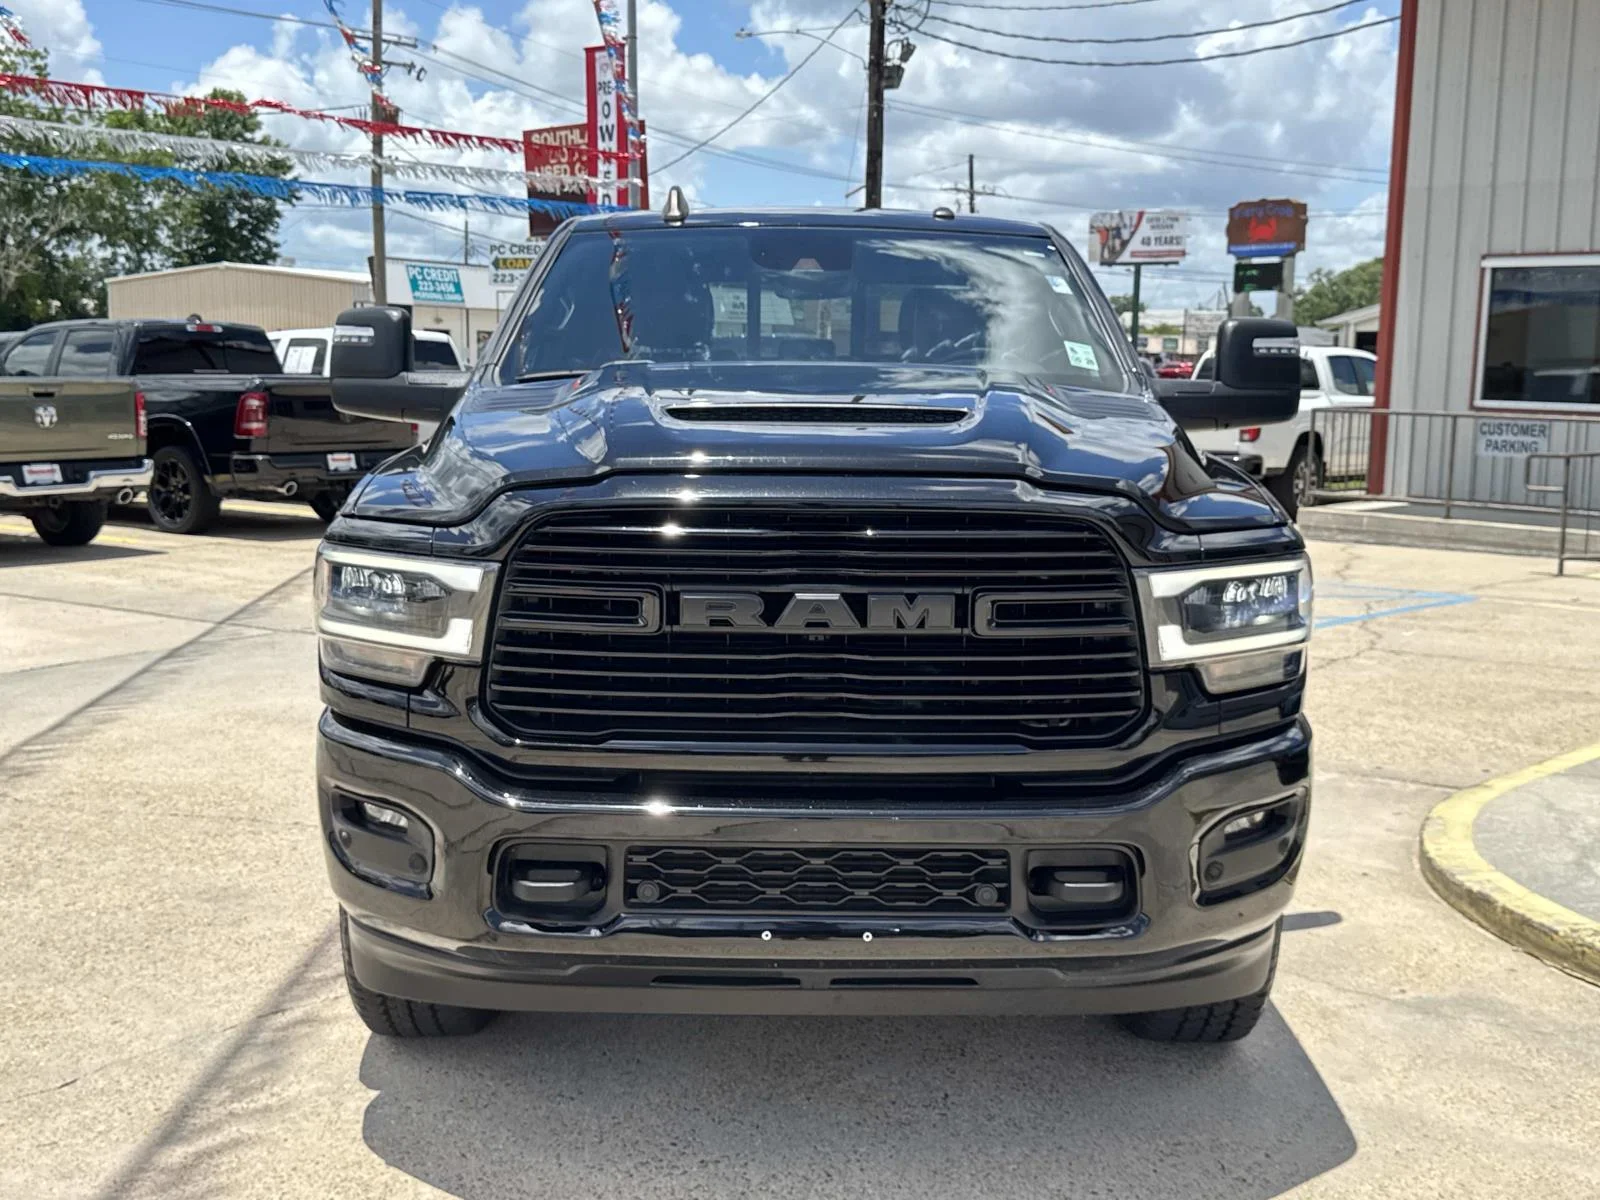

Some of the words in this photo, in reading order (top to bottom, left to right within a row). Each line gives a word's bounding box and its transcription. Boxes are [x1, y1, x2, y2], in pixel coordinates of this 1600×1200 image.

[490, 244, 506, 255] PC
[509, 243, 541, 255] CRED
[408, 266, 422, 280] PC
[423, 267, 458, 283] CREDIT
[493, 273, 525, 283] 223-
[1480, 422, 1547, 438] CUSTOMER
[1484, 439, 1538, 453] PARKING
[680, 592, 955, 629] RAM
